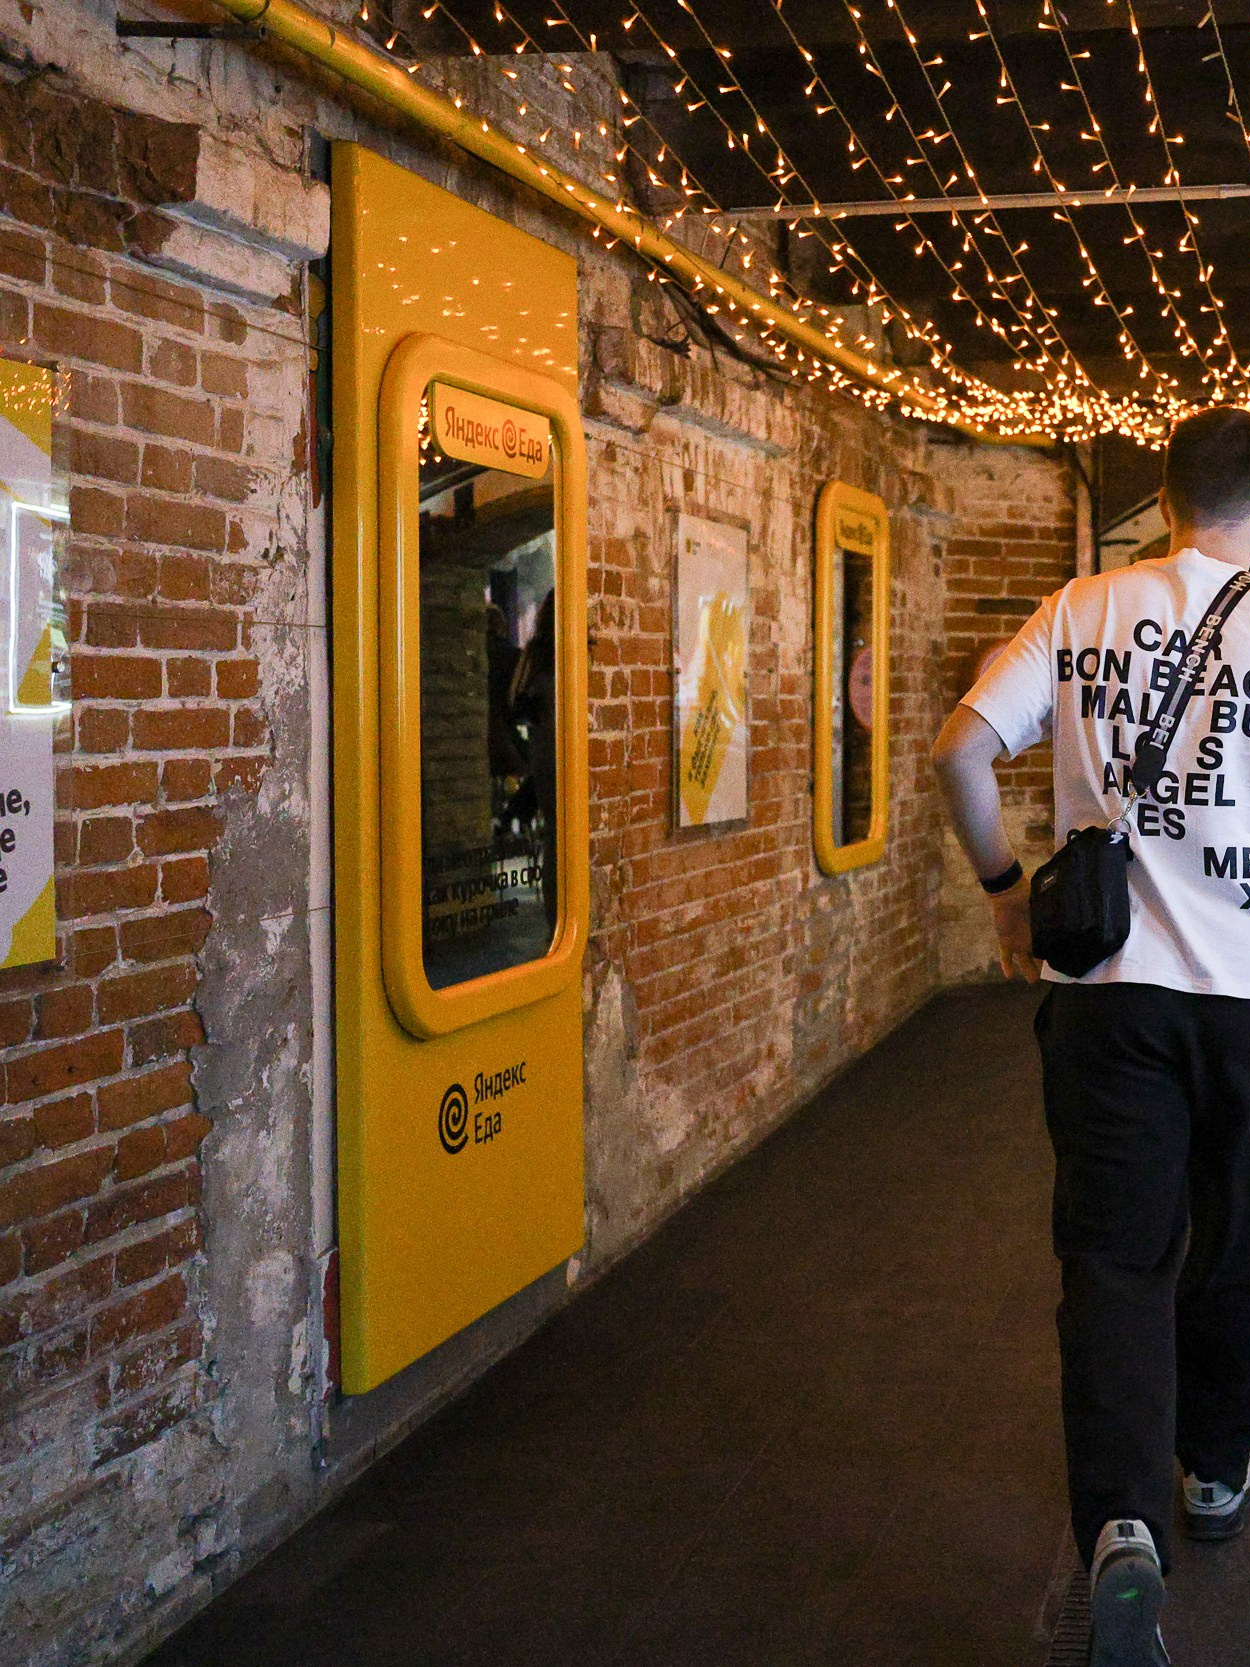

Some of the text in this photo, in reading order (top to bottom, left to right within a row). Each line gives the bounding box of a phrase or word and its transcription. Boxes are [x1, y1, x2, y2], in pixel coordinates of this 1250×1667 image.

[445, 405, 543, 465] Яндекс Еда
[1057, 648, 1132, 684] BON
[1178, 614, 1222, 682] BENCH
[1137, 803, 1186, 840] ES
[474, 1061, 527, 1105] Яндекс
[474, 1111, 502, 1145] Еда
